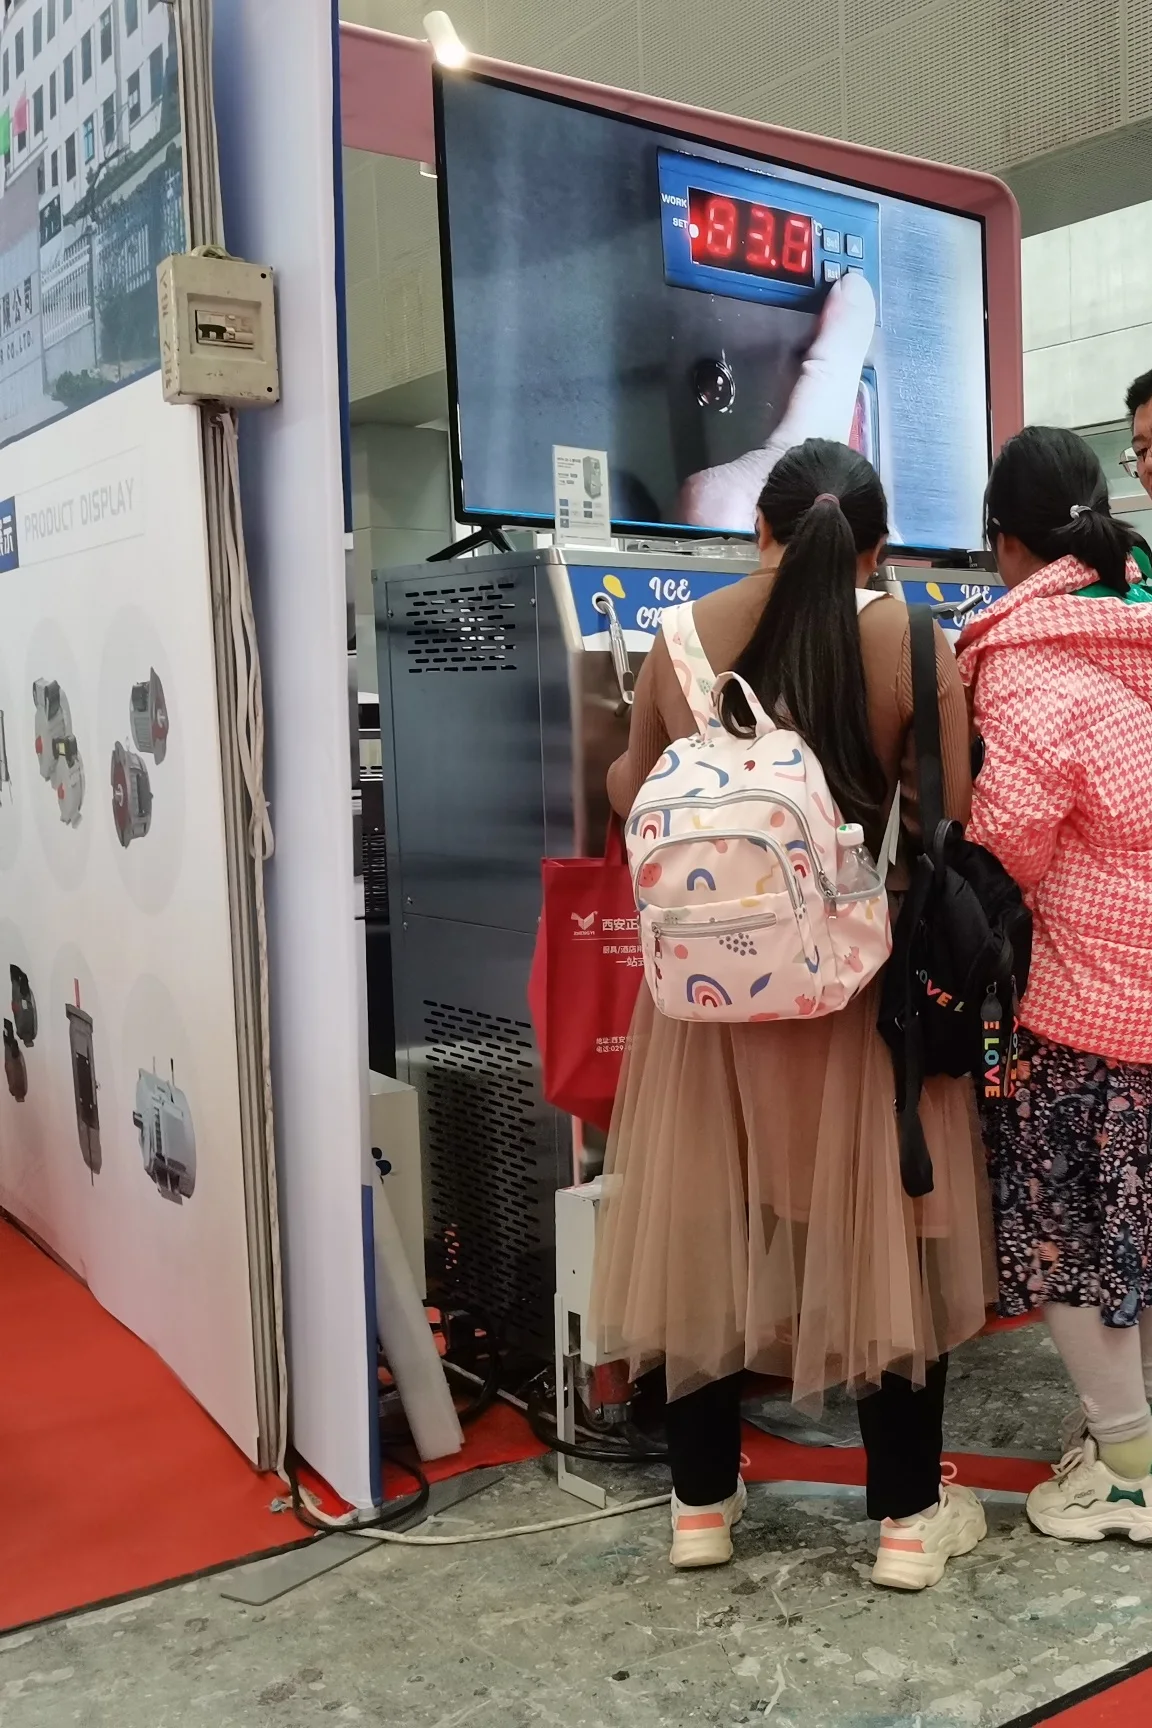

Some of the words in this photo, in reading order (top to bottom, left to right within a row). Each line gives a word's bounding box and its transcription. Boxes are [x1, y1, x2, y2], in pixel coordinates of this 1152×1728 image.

[661, 192, 687, 209] WORK
[672, 217, 688, 229] SET
[24, 498, 74, 542] PRODUCT
[80, 477, 134, 526] DISPLAY
[0, 515, 14, 556] 示
[649, 576, 691, 601] ICE
[636, 606, 663, 629] CR
[602, 917, 639, 931] 西安正
[916, 969, 953, 1007] OVE
[984, 1037, 1001, 1098] LOVE
